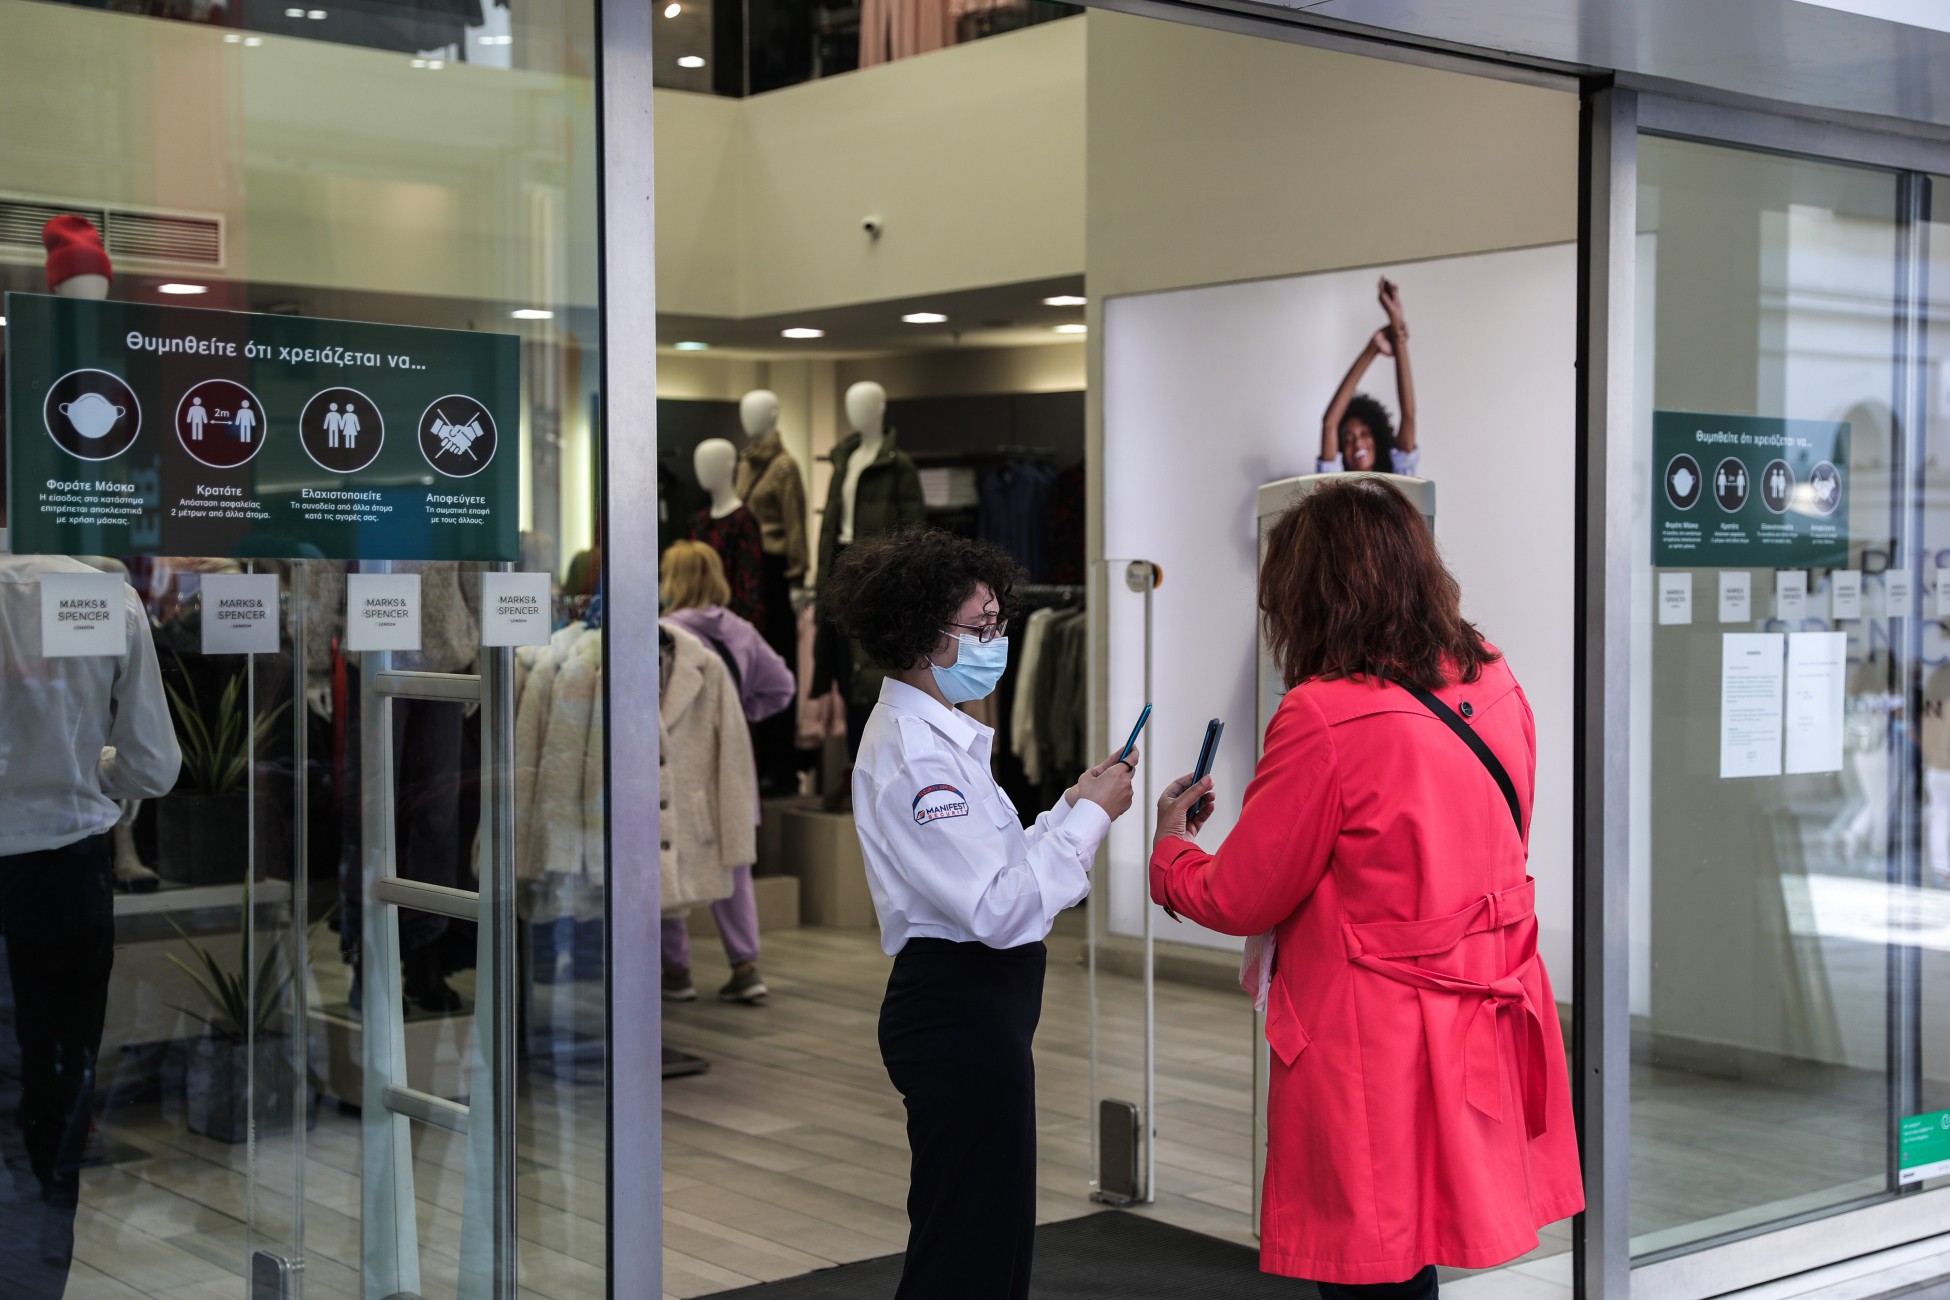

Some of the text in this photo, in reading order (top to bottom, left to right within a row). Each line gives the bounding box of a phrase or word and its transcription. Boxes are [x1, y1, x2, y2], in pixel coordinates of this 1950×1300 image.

[126, 331, 237, 356] Θυμηθείτε
[244, 340, 271, 360] ότι
[279, 346, 381, 368] χρειάζεται
[214, 408, 230, 418] 2m
[46, 479, 135, 492] Φοράτε Μάσκα
[196, 484, 242, 497] Κρατάτε
[39, 493, 46, 501] Η
[49, 493, 82, 503] είσοδος
[100, 496, 144, 505] κατάστημα
[302, 488, 382, 501] Ελαχιστοποιείτε
[425, 493, 486, 505] Αποφεύγετε
[179, 499, 261, 509] Απόσταση ασφαλείας
[290, 501, 300, 509] Τη
[302, 502, 335, 510] συνοδεία
[352, 503, 370, 511] άλλα
[371, 504, 393, 512] άτομα
[40, 505, 143, 514] επιτρέπεται αποκλειστικά
[170, 508, 271, 520] 2 μέτρων από άλλα άτομα.
[56, 516, 66, 524] με
[68, 516, 94, 525] χρήση
[304, 512, 322, 520] κατά
[324, 513, 334, 521] τις
[59, 599, 107, 609] MARKS &
[219, 599, 263, 608] MARKS &
[366, 598, 407, 607] MARKS &
[500, 595, 537, 604] MARKS &
[217, 610, 266, 620] SPENCER
[365, 609, 409, 618] SPENCER
[498, 606, 539, 615] SPENCER
[58, 611, 110, 621] SPENCER
[926, 802, 966, 814] MANIFEST
